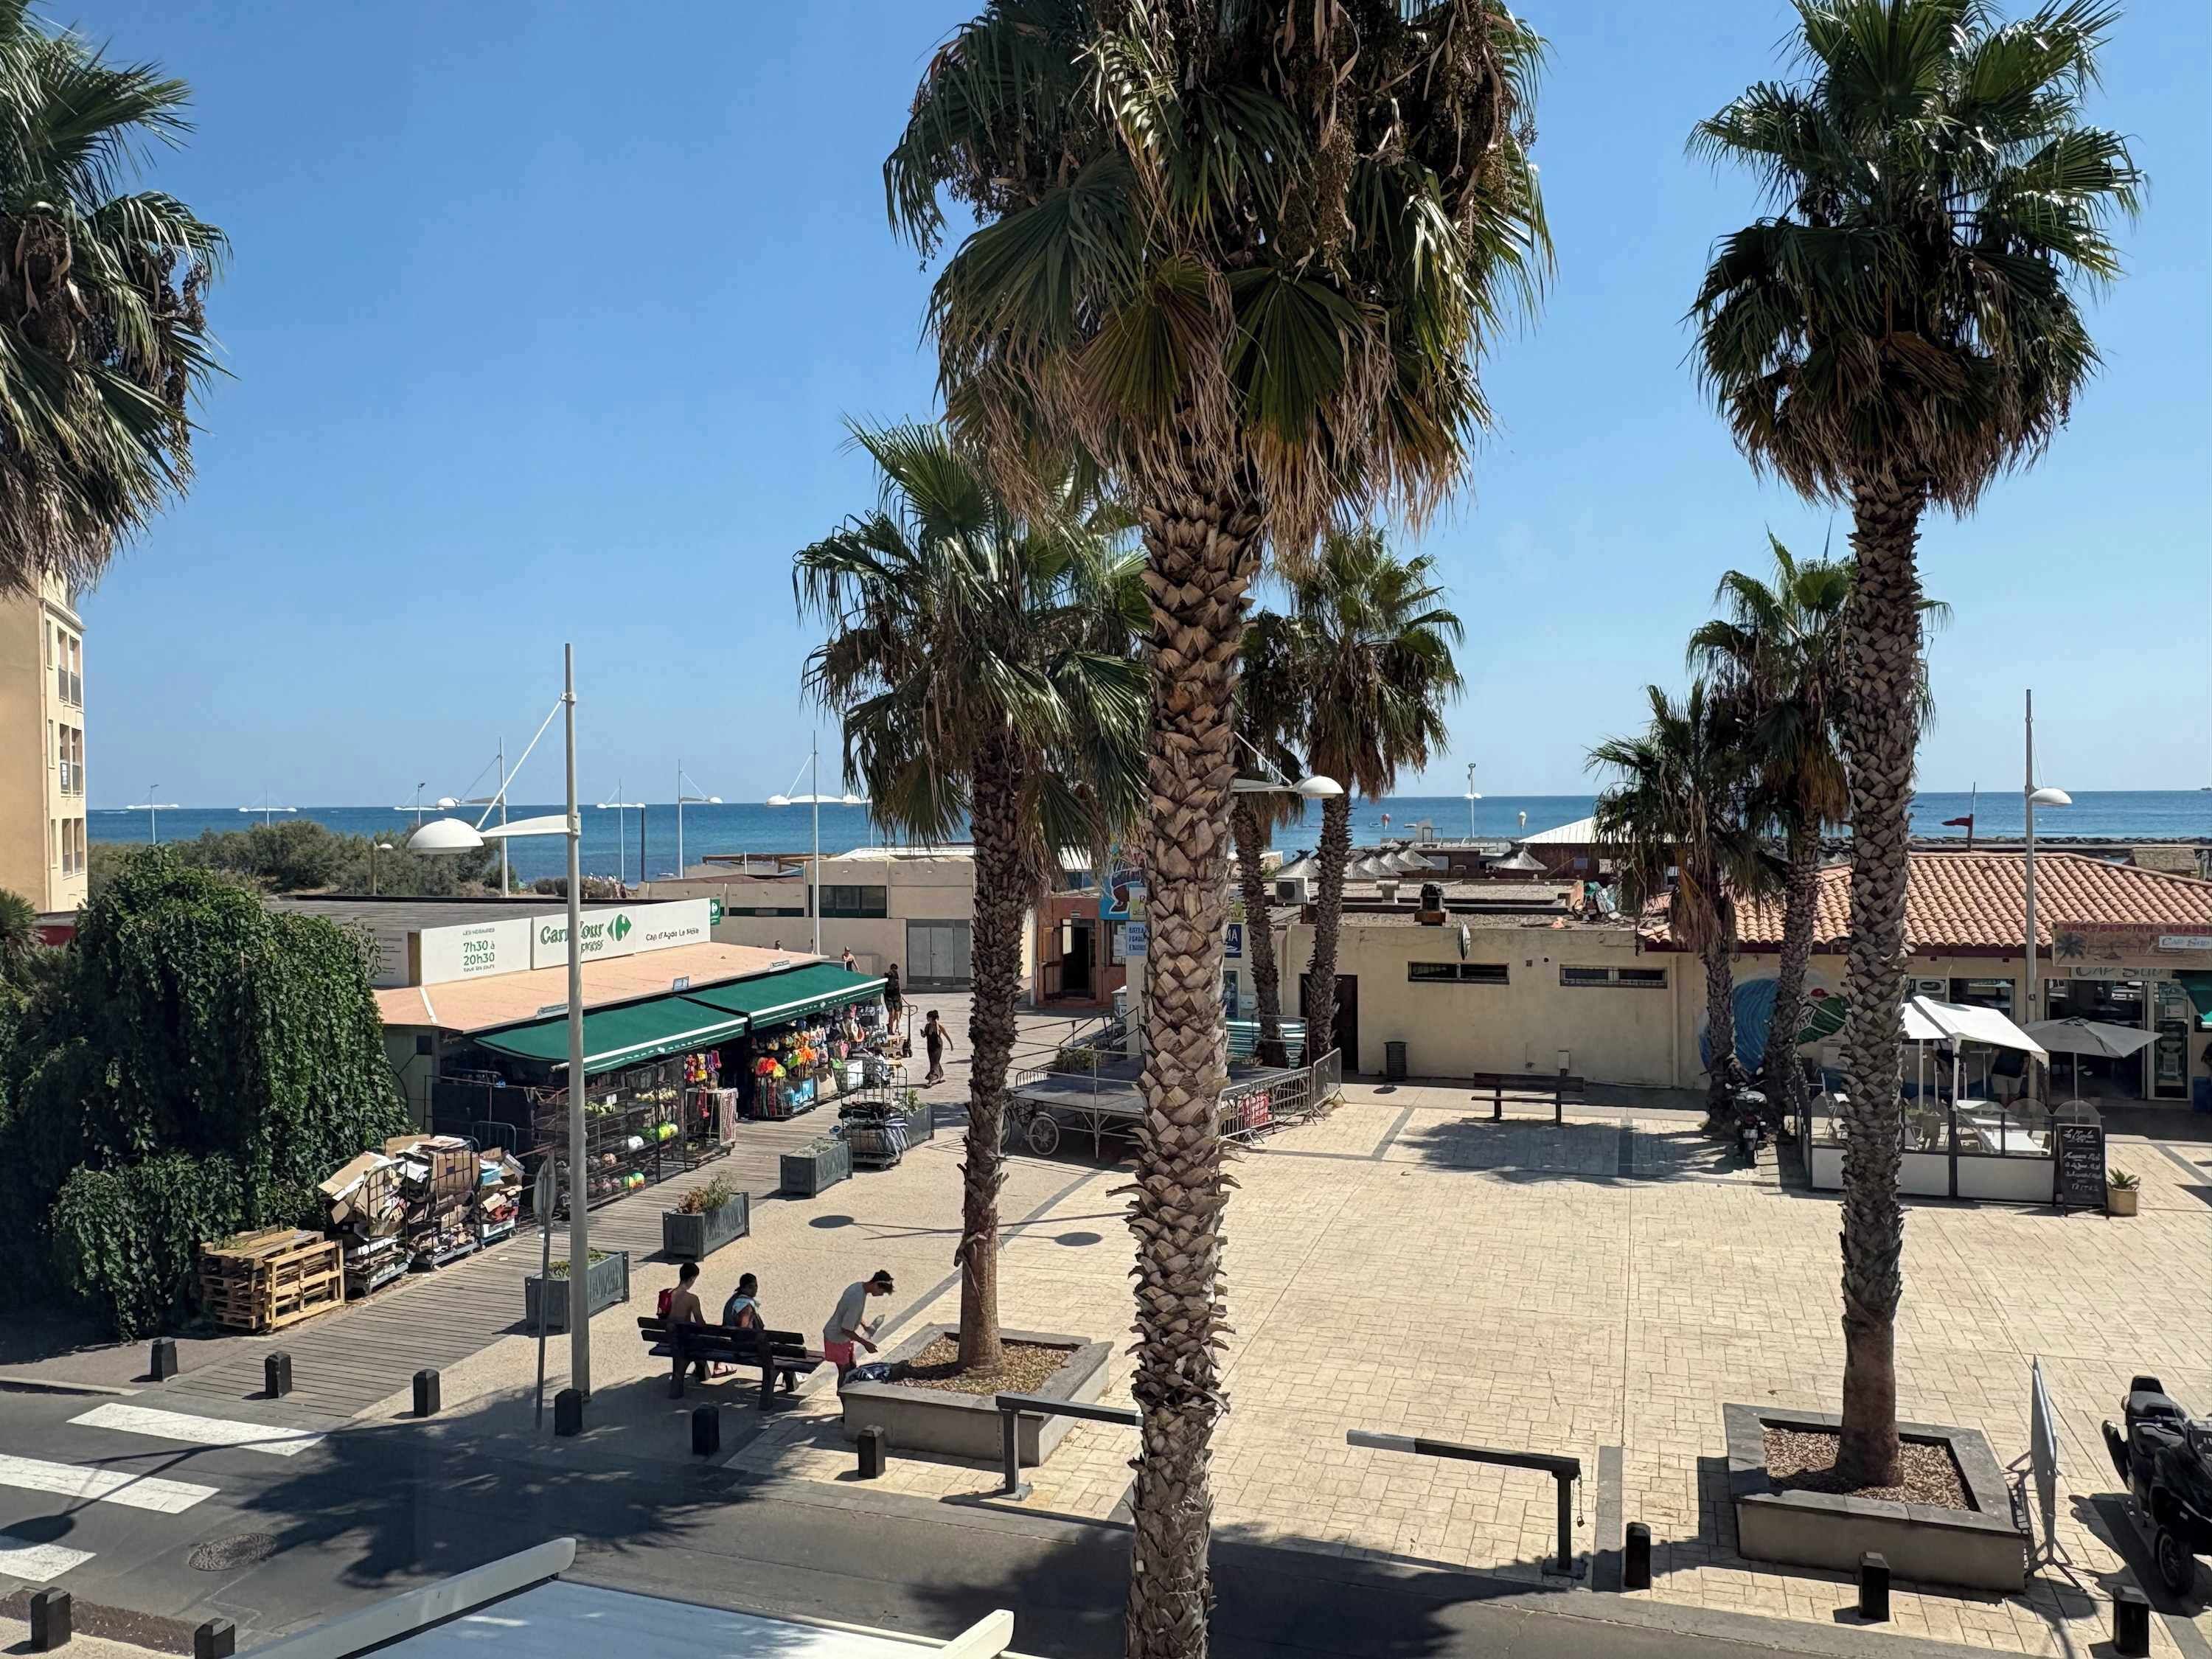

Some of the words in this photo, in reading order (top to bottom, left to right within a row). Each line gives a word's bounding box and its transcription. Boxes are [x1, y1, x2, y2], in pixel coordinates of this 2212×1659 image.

[540, 920, 605, 945] Carrour
[463, 939, 489, 953] 7h30
[580, 939, 604, 953] press
[463, 952, 495, 967] 20h30
